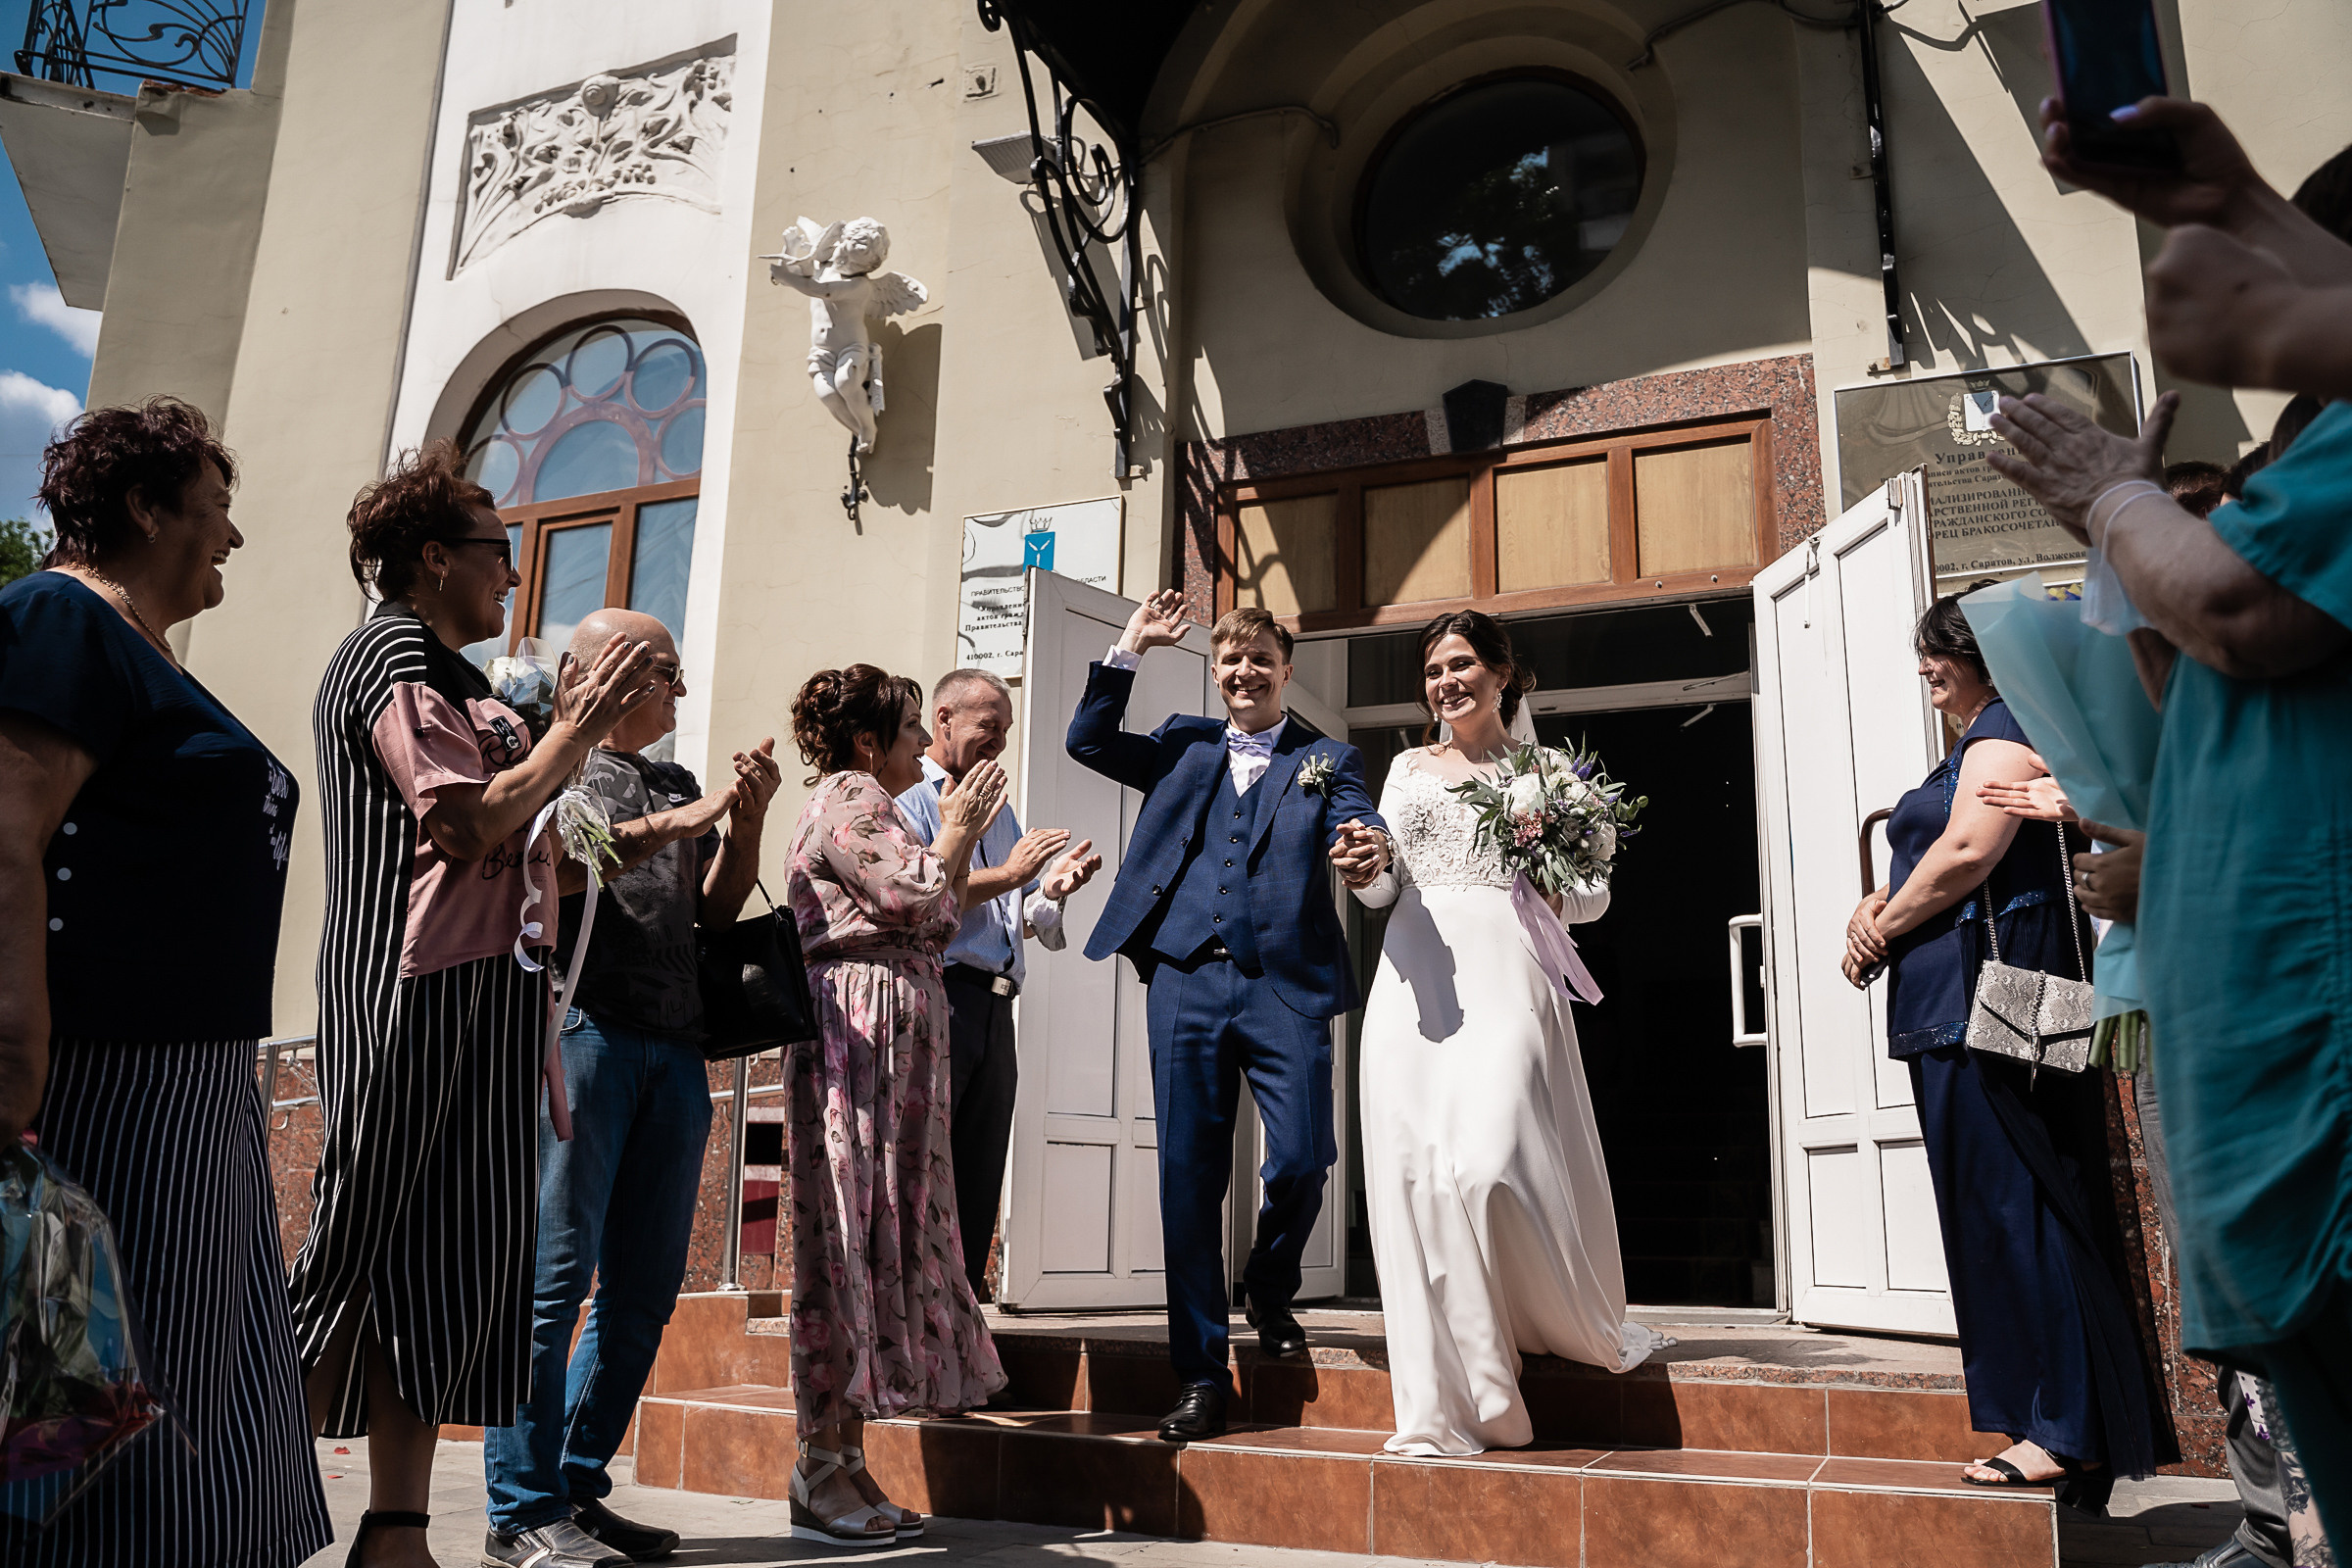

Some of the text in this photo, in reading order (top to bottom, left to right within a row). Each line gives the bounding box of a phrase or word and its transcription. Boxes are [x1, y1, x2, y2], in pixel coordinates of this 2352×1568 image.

[1954, 466, 1981, 475] актов
[1931, 498, 2008, 517] РСТВЕННОЙ
[1932, 528, 1959, 540] РЕЦ
[1971, 559, 2016, 569] Саратов,
[965, 619, 1022, 633] Правительства
[966, 651, 995, 661] 410002,
